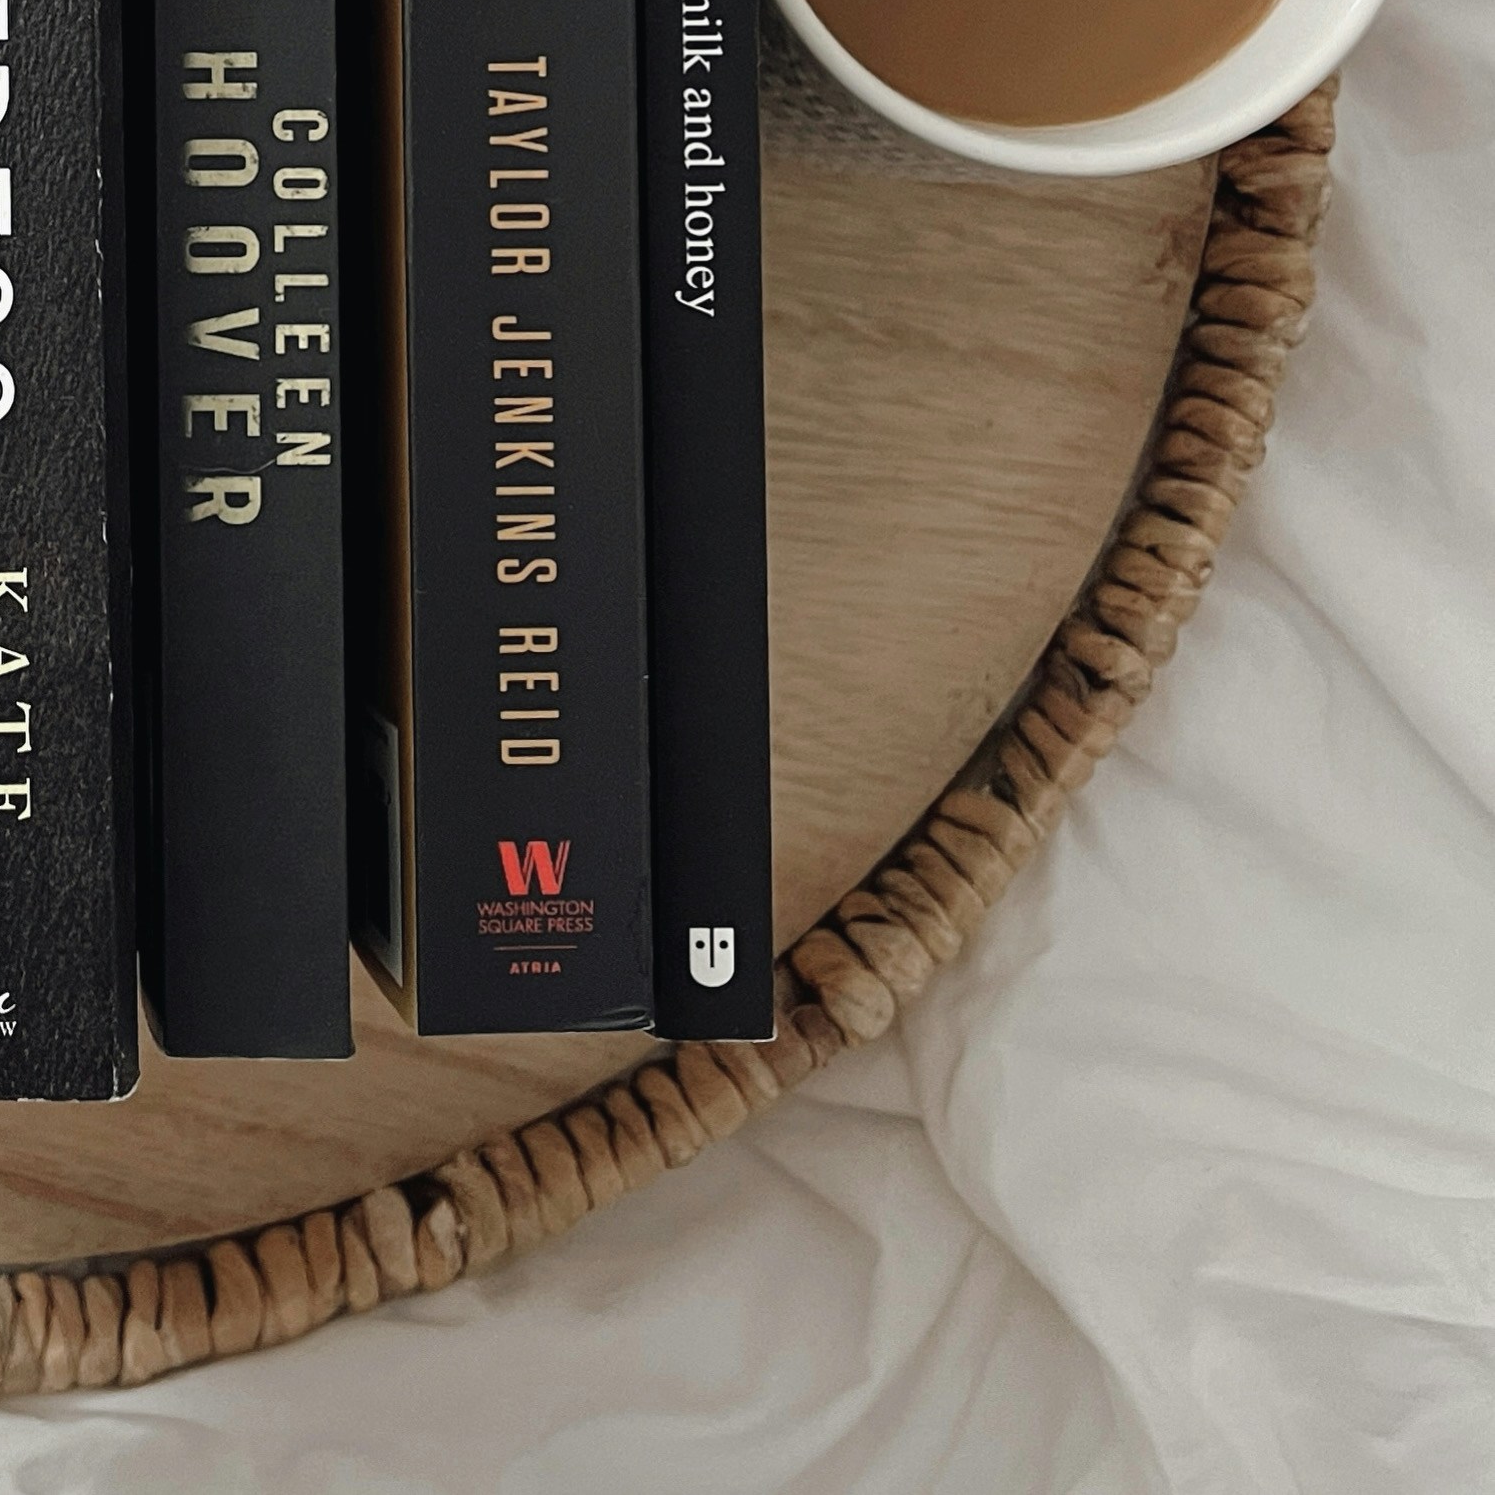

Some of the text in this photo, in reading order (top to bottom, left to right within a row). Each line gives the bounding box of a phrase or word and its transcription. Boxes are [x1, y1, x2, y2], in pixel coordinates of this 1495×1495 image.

[683, 87, 726, 169] and
[183, 51, 262, 525] HOOVER
[272, 109, 331, 466] COLLEEN
[674, 182, 726, 317] honey
[487, 56, 560, 765] TAYLOR JENKINS REID
[477, 900, 594, 917] WASHINGTON
[498, 840, 570, 896] W
[479, 917, 593, 934] SQUARE PRESS
[508, 960, 562, 975] ATRIA
